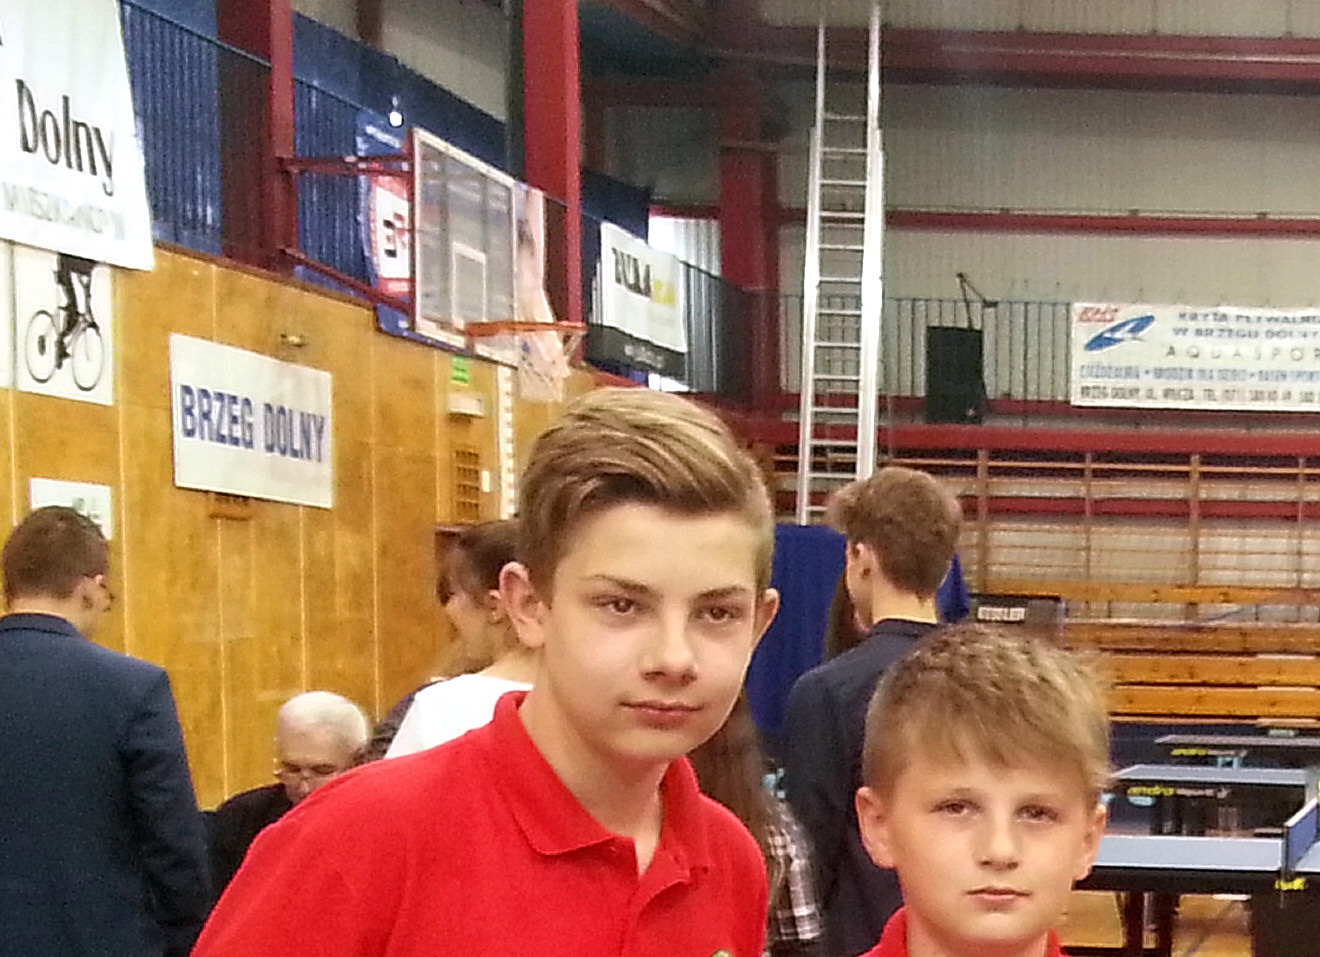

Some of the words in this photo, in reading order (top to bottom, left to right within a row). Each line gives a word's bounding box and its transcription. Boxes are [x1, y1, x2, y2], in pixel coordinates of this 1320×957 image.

[15, 78, 115, 197] Dolny
[179, 384, 255, 450] BRZEG
[263, 402, 326, 463] DOLNY
